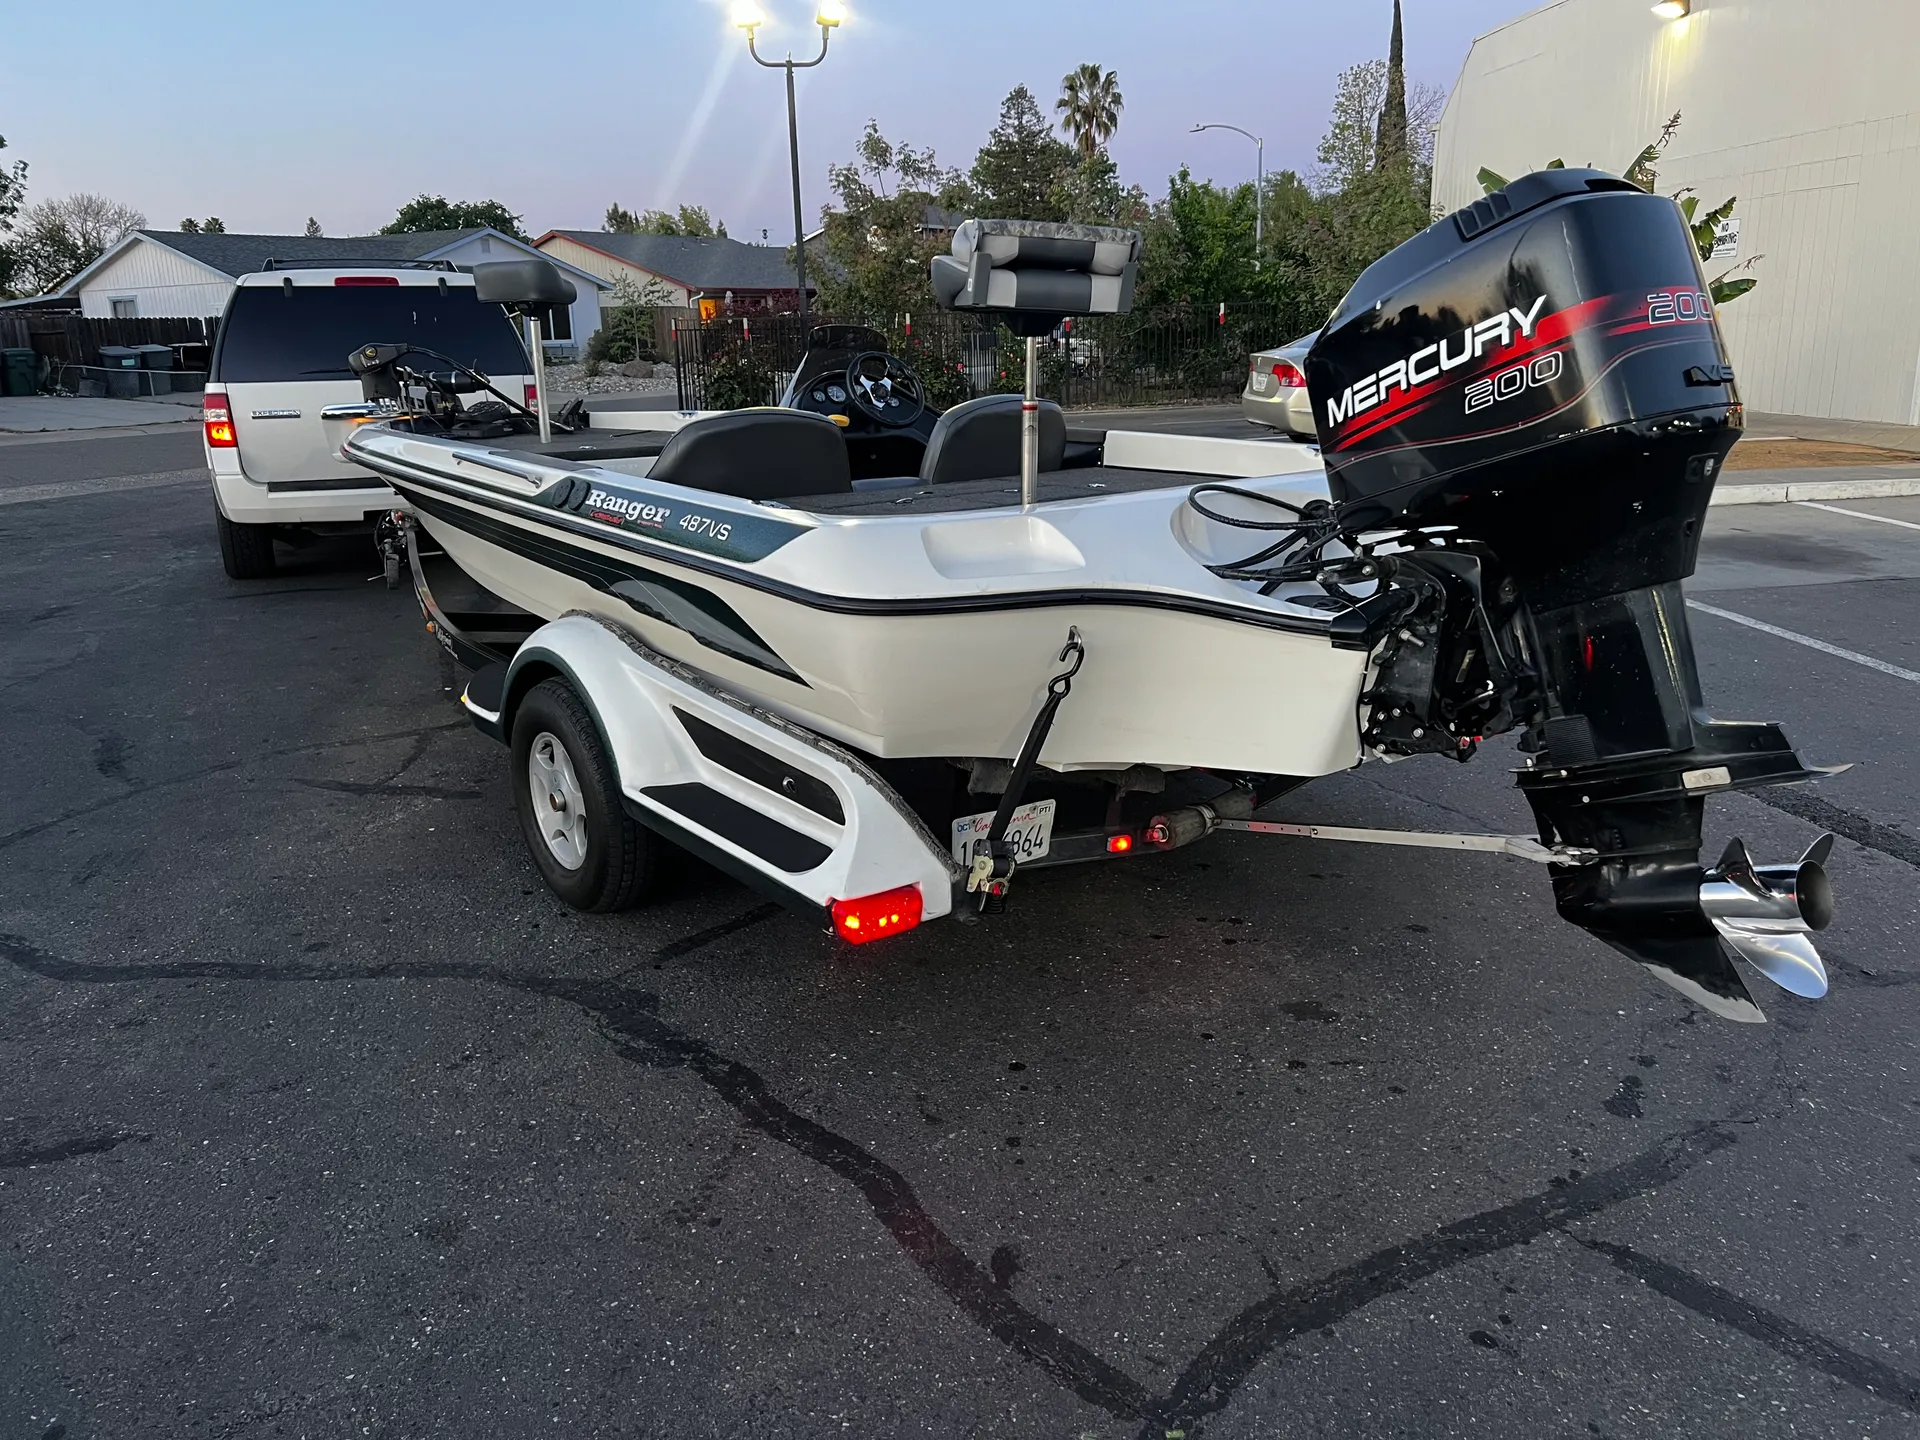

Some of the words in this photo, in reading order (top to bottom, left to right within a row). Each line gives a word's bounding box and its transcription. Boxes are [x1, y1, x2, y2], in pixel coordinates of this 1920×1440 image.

[1720, 222, 1730, 233] NO
[1647, 291, 1713, 325] 200
[1326, 294, 1548, 428] MERCURY
[1464, 350, 1563, 415] 200
[585, 489, 671, 523] Ranger
[679, 514, 733, 541] 487VS
[1038, 806, 1051, 815] PTI
[961, 824, 1044, 866] 1864
